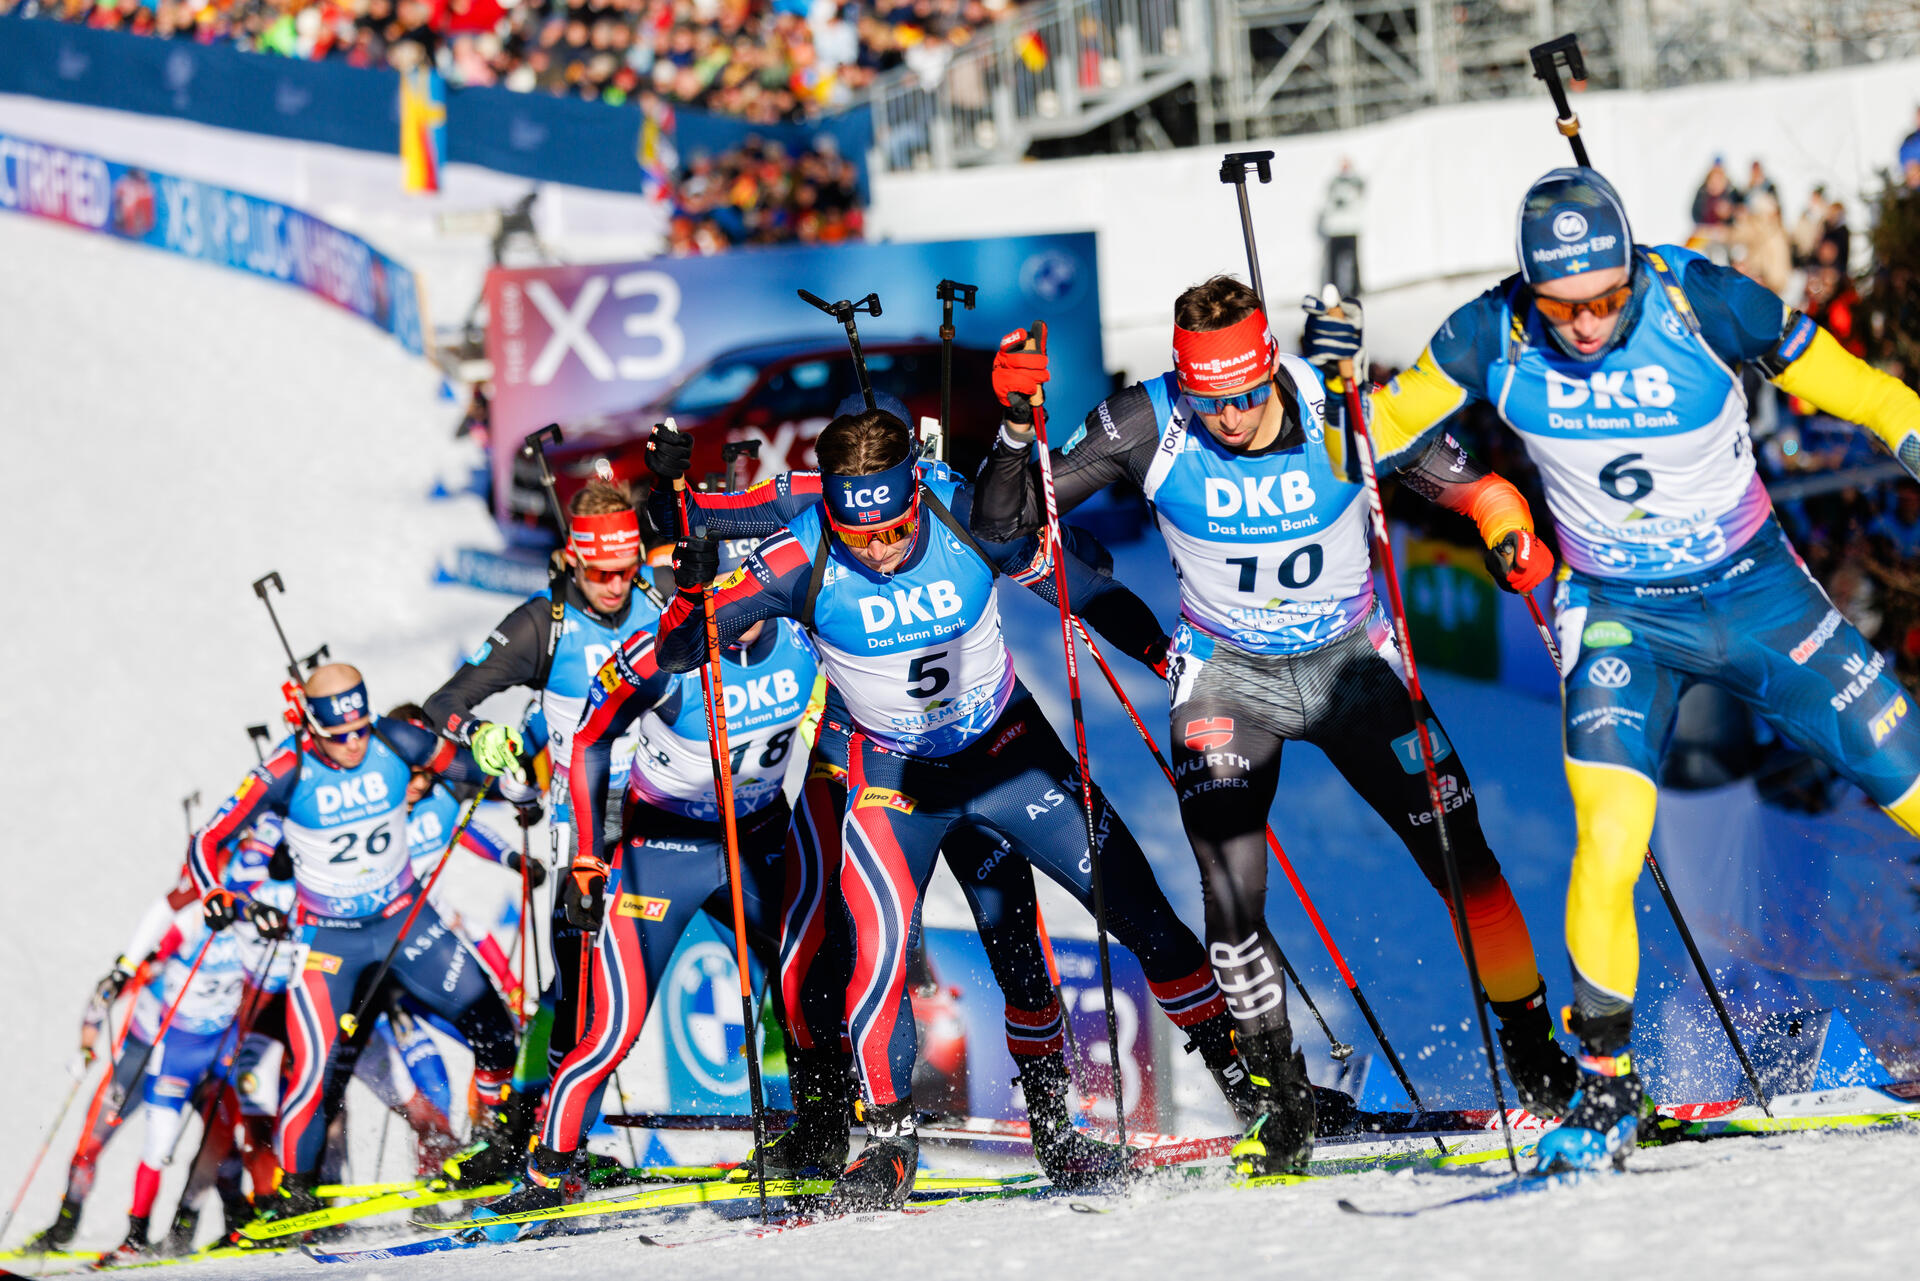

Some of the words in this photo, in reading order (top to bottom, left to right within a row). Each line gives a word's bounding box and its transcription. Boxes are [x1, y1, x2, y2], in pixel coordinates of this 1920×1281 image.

[1533, 243, 1590, 262] Monitor
[1590, 235, 1617, 252] ERP
[525, 270, 686, 386] X3
[1544, 364, 1677, 409] DKB
[1549, 412, 1584, 429] Das
[1587, 413, 1631, 429] kann
[1634, 410, 1680, 428] Bank
[843, 481, 891, 508] ice
[1205, 470, 1317, 518] DKB
[1598, 453, 1653, 503] 6
[1208, 521, 1237, 536] Das
[1240, 523, 1278, 536] kann
[1281, 514, 1320, 532] Bank
[1225, 543, 1324, 593] 10
[858, 579, 963, 634] DKB
[867, 637, 894, 649] Das
[897, 629, 931, 643] kann
[933, 617, 967, 636] Bank
[724, 669, 799, 719] DKB
[906, 650, 950, 699] 5
[331, 691, 364, 716] ice
[745, 713, 773, 726] kann
[774, 702, 801, 718] Bank
[891, 684, 983, 726] CHIEMGAU
[950, 696, 997, 748] X3
[728, 726, 797, 775] 18
[1173, 752, 1250, 781] WÜRTH
[315, 771, 390, 816] DKB
[864, 792, 889, 801] Uno
[1193, 778, 1249, 794] TERREX
[329, 822, 391, 864] 26
[408, 811, 442, 845] KB
[645, 838, 699, 853] LAPUA
[622, 900, 643, 911] Uno
[404, 920, 450, 961] ASK
[1210, 931, 1284, 1021] GER
